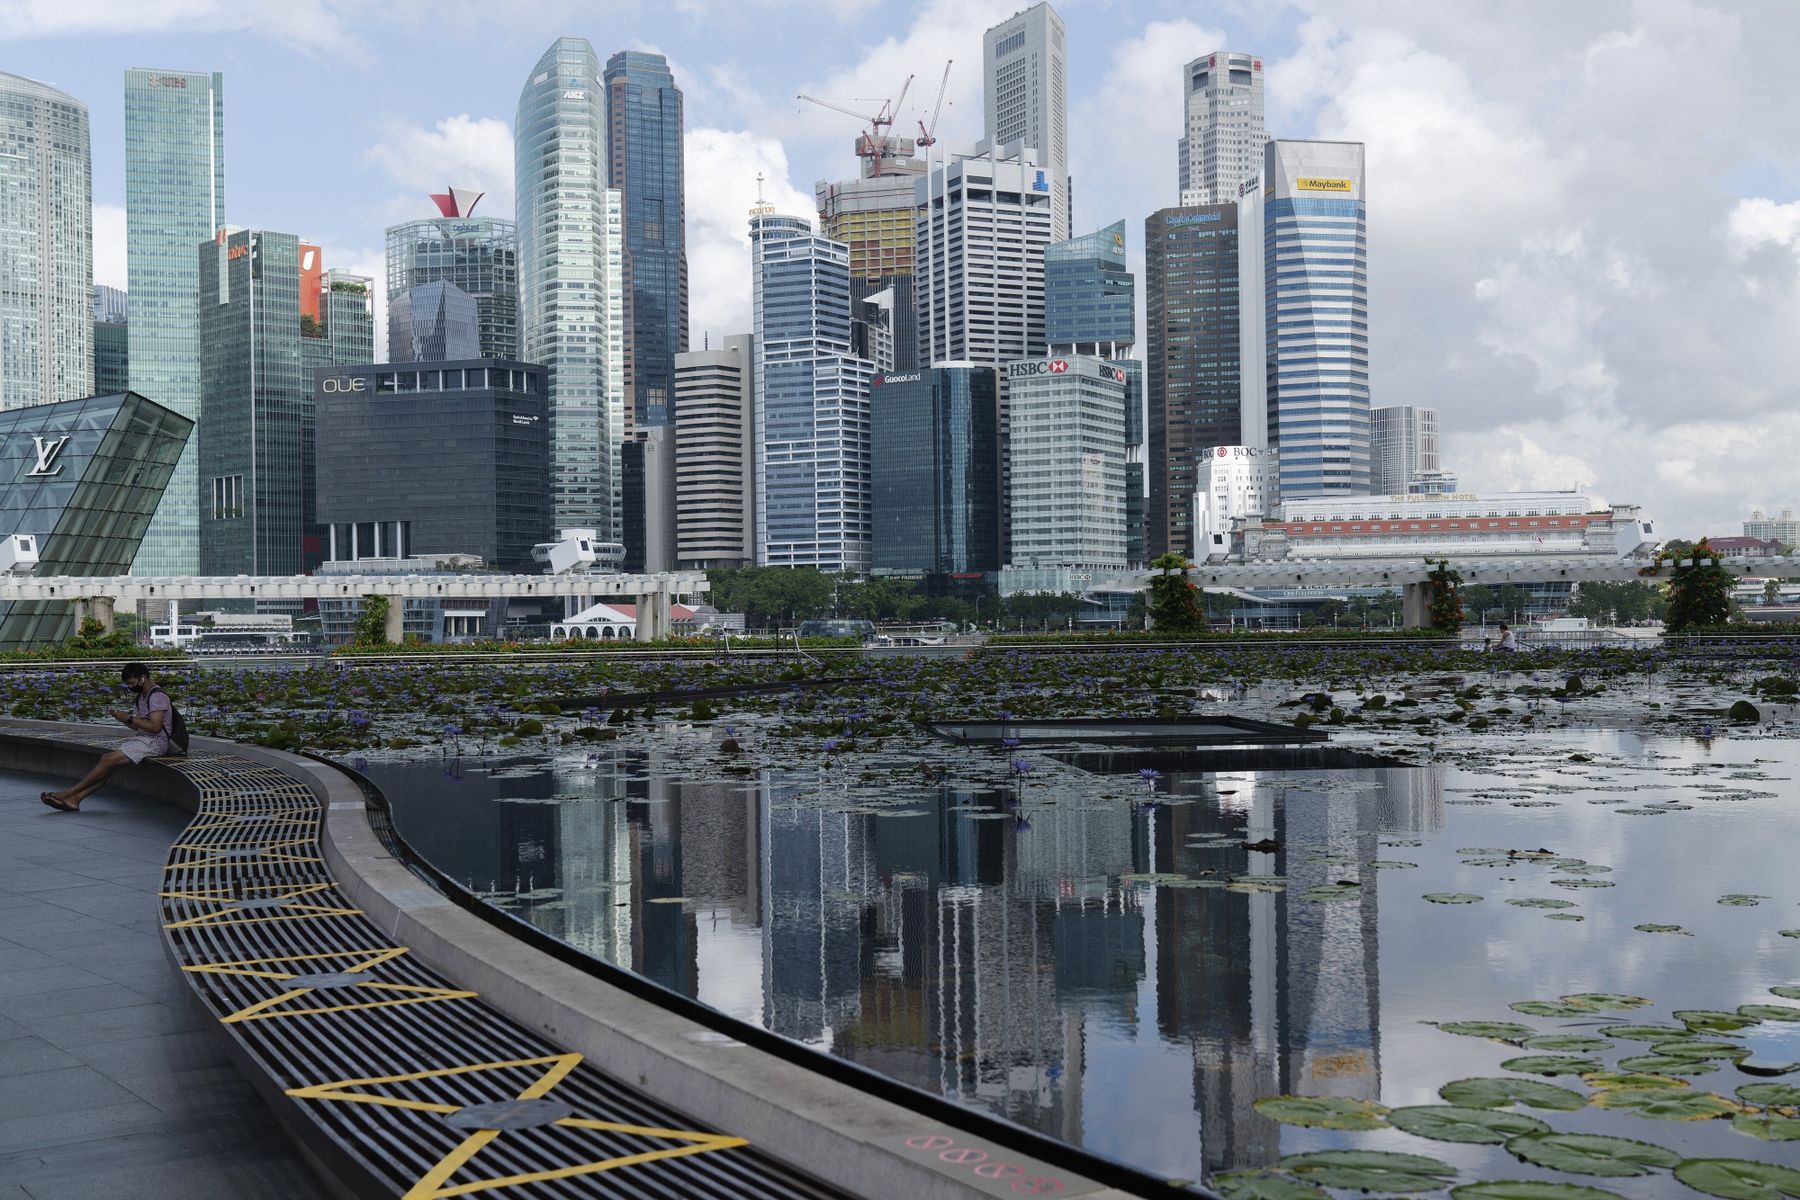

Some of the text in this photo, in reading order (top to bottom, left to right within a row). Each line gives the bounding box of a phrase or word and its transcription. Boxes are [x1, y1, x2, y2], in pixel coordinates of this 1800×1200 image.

[1309, 180, 1347, 189] Maybank
[1009, 361, 1047, 377] HSBC
[1099, 364, 1116, 380] HSBC
[322, 377, 366, 393] OUE
[1233, 446, 1257, 457] BOC
